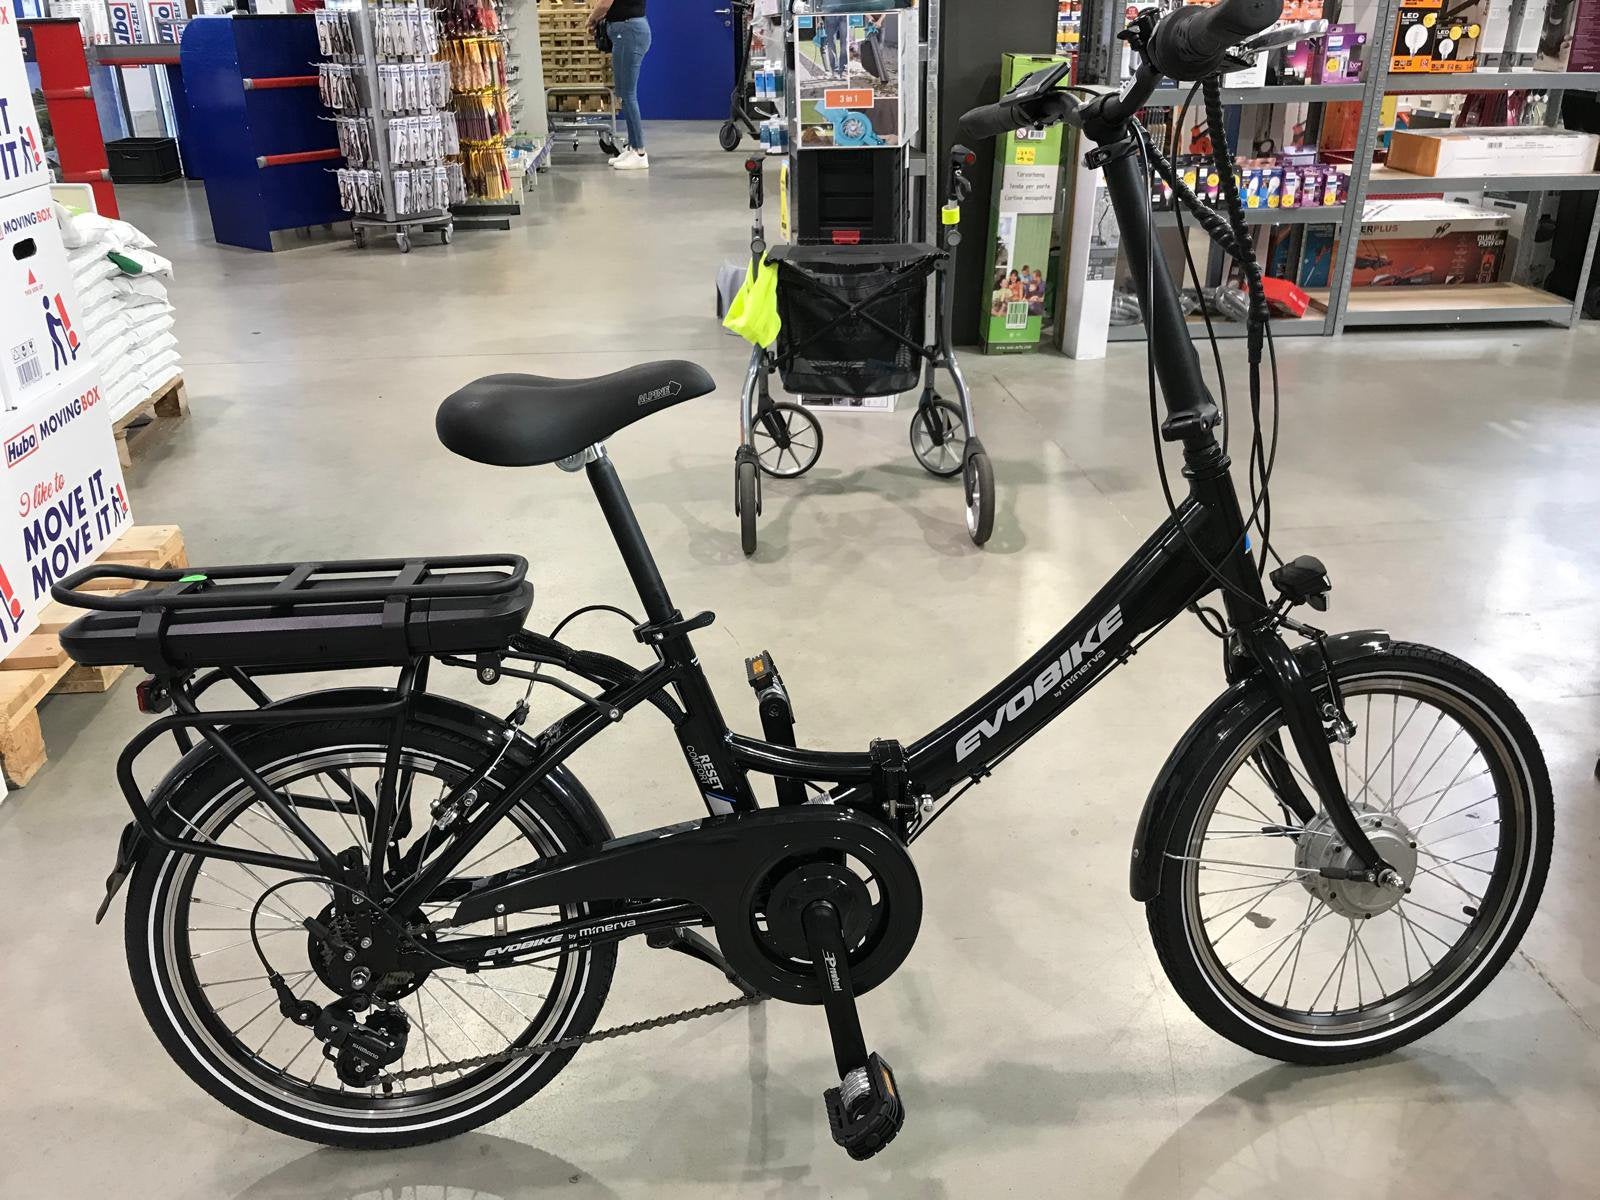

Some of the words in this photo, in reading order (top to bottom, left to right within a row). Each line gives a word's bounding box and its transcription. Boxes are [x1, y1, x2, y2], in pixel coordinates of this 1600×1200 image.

[113, 7, 130, 44] ubo
[840, 95, 845, 103] 3
[3, 207, 52, 235] MOVINGBOX
[1478, 239, 1504, 247] POWER
[7, 434, 36, 462] Hubo
[39, 385, 101, 441] MOVINGBOX
[33, 481, 53, 509] like
[54, 472, 65, 493] to
[23, 485, 87, 563] MOVE
[88, 468, 105, 507] IT
[31, 520, 93, 601] MOVE
[96, 503, 111, 541] IT
[955, 603, 1124, 763] EVOBIKE
[1060, 649, 1106, 691] minerva
[686, 745, 711, 785] COMFORT
[698, 754, 724, 791] RESET
[484, 933, 564, 957] EVOBIKE
[579, 918, 636, 937] minerva
